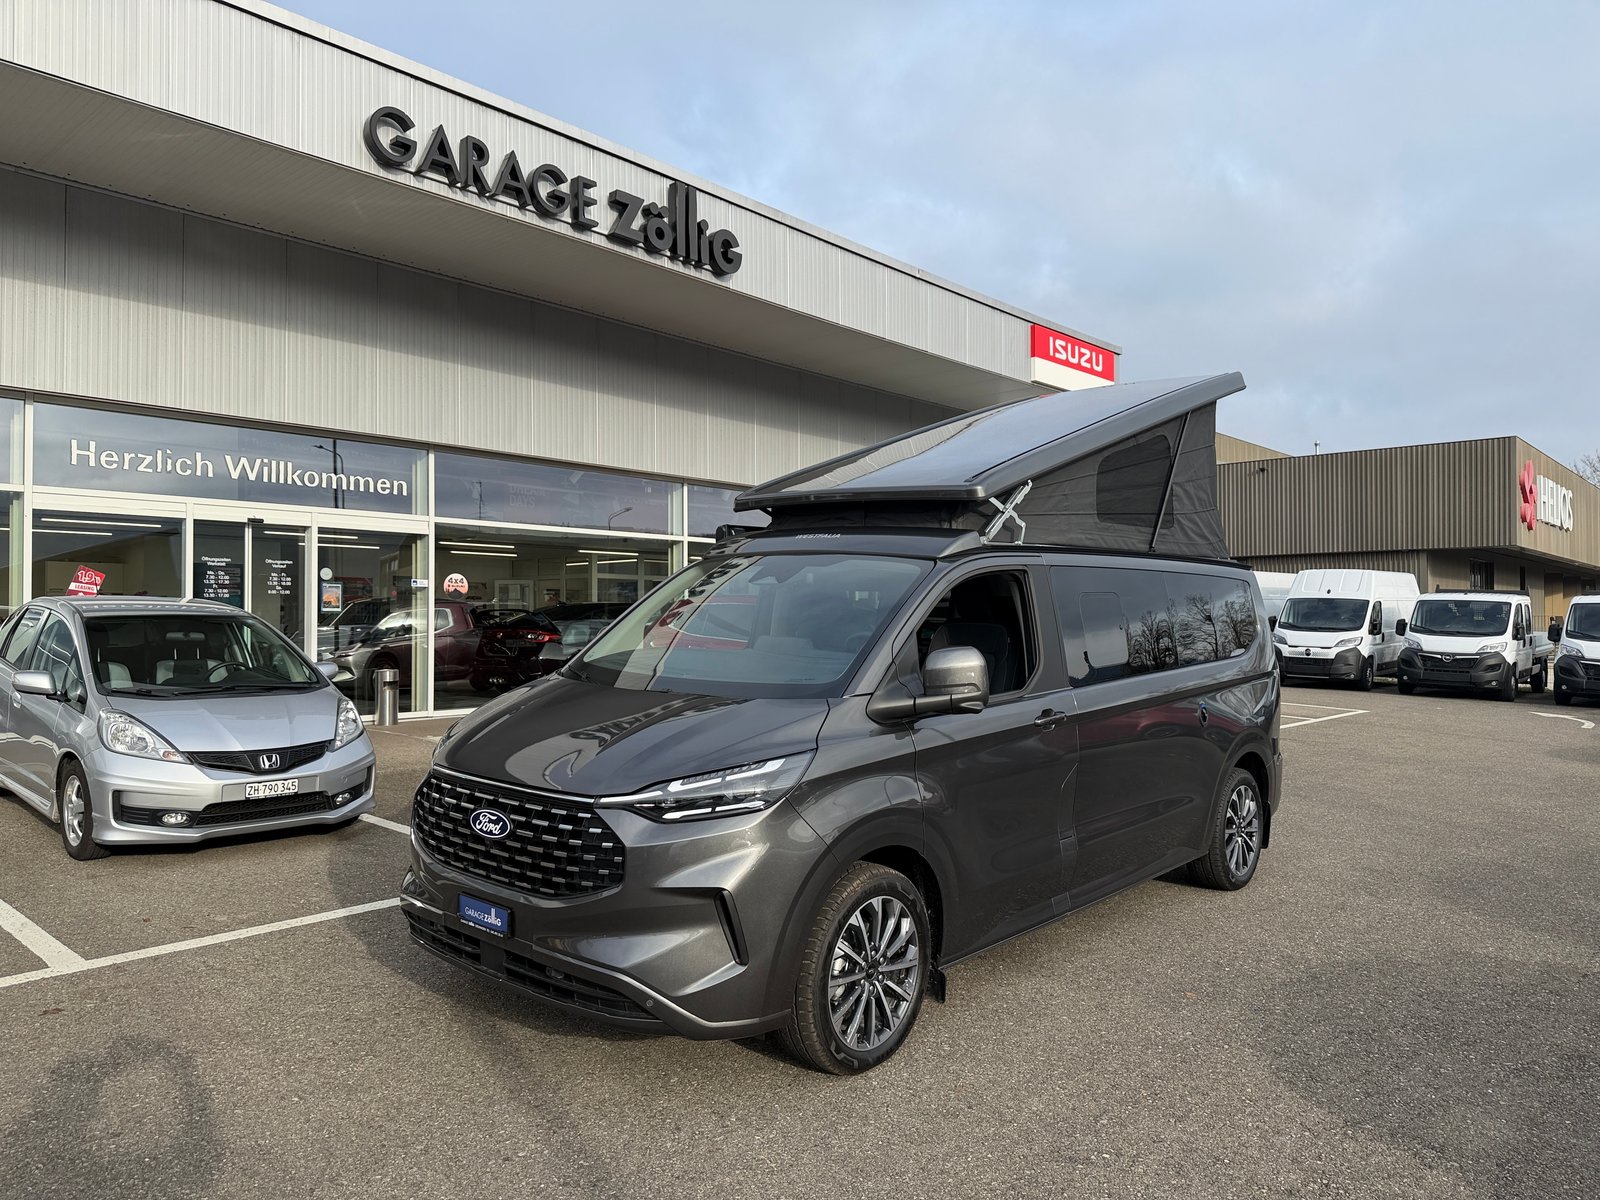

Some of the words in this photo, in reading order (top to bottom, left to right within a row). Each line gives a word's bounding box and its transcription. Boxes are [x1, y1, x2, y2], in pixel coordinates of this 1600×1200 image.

[363, 106, 599, 231] GARAGE
[1049, 336, 1103, 372] ISUZU
[70, 439, 214, 478] Herzlich
[224, 454, 408, 497] Willkommen
[1536, 474, 1574, 532] HELIOS
[74, 583, 95, 591] LEASING
[280, 780, 297, 793] 345
[475, 812, 503, 835] Ford
